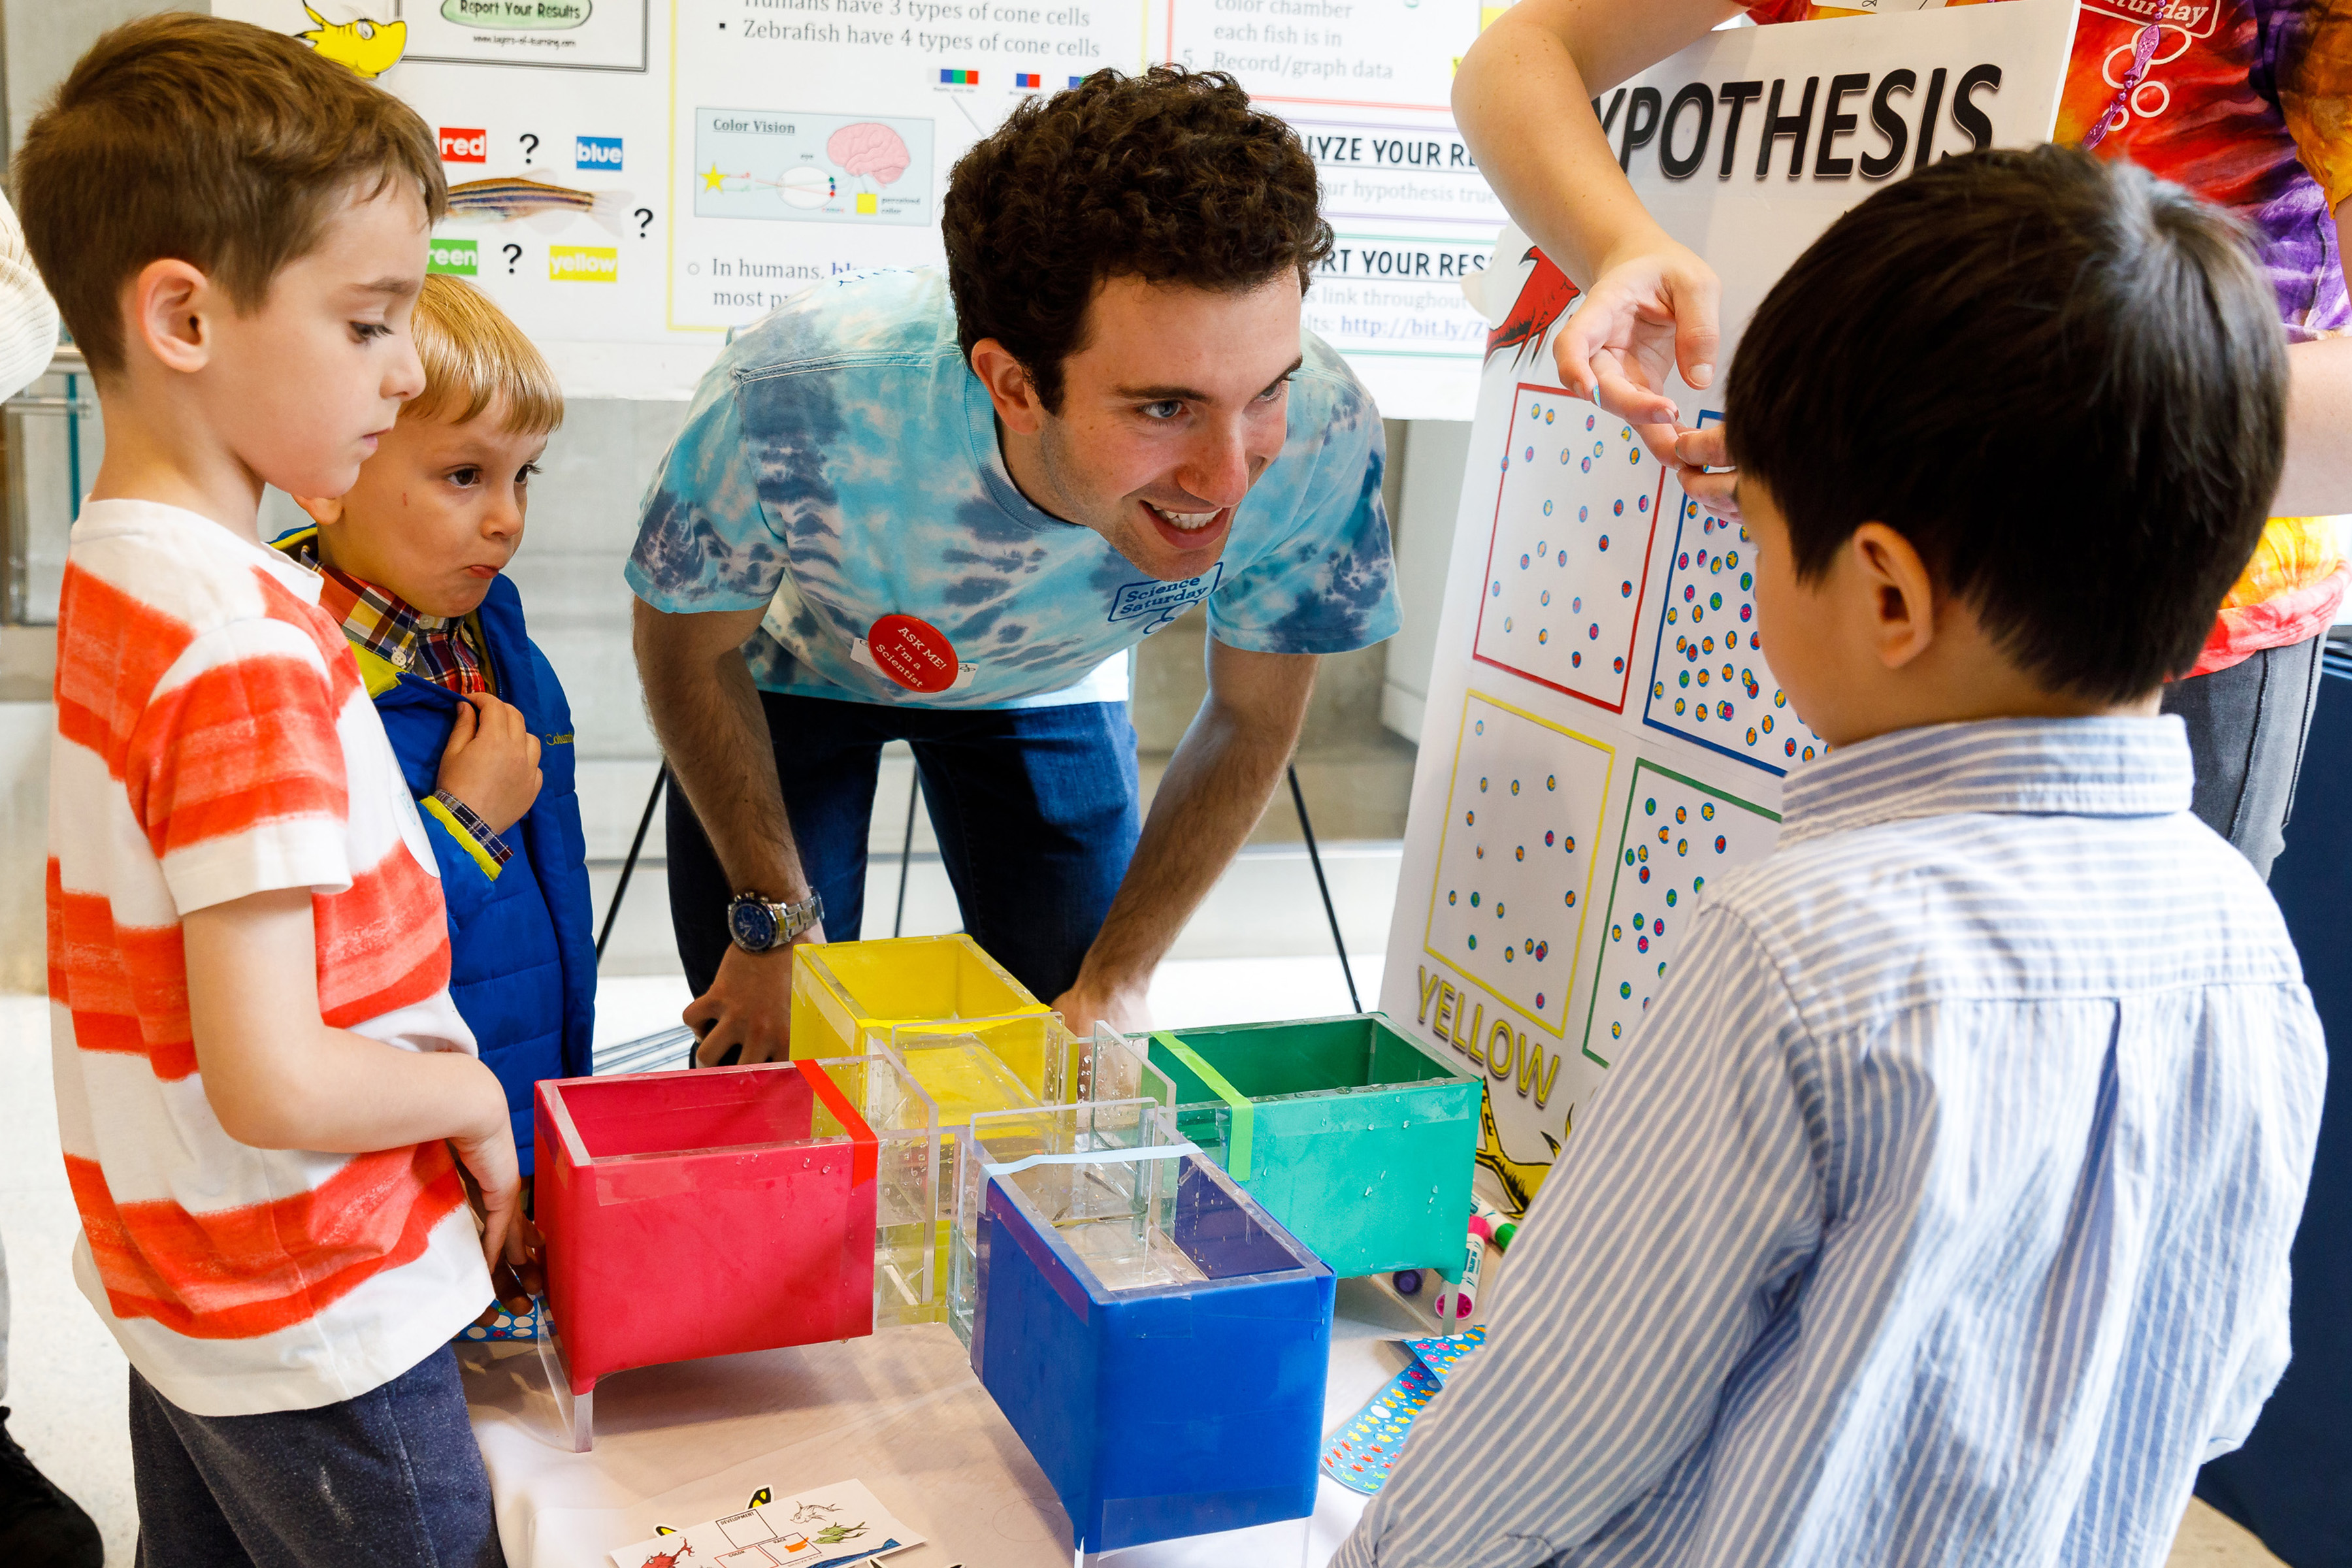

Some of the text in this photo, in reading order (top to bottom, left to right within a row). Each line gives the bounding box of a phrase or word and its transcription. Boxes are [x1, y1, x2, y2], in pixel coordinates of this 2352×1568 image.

[459, 0, 581, 20] Report Your Results
[837, 0, 883, 14] have
[890, 0, 901, 16] 3
[909, 1, 962, 22] types
[969, 1, 989, 20] of
[994, 7, 1041, 24] cone
[1047, 7, 1091, 26] cells
[1269, 0, 1354, 19] chamber
[743, 20, 1100, 57] Zebrafish have 4 types of cone cells
[1214, 24, 1343, 47] each fish is in
[1214, 50, 1347, 80] Record/graph
[1352, 60, 1394, 79] data
[713, 119, 796, 135] Color Vision
[1592, 63, 2002, 179] YPOTHESIS
[441, 135, 485, 157] red
[519, 134, 539, 164] ?
[577, 143, 622, 164] blue
[1307, 136, 1362, 161] LYZE
[1373, 140, 1441, 166] YOUR
[1353, 180, 1452, 204] hypothesis
[634, 208, 653, 238] ?
[428, 247, 478, 266] reen
[503, 244, 522, 273] ?
[551, 253, 617, 274] yellow
[713, 259, 731, 276] In
[1362, 251, 1430, 276] YOUR
[713, 292, 764, 307] most
[1120, 587, 1209, 614] Saturday
[1125, 578, 1200, 603] Science
[898, 627, 924, 651] ASK
[923, 649, 947, 670] ME!
[876, 644, 923, 688] Scientist
[1418, 965, 1560, 1105] YELLOW
[720, 1511, 755, 1526] DEVELOPMENT
